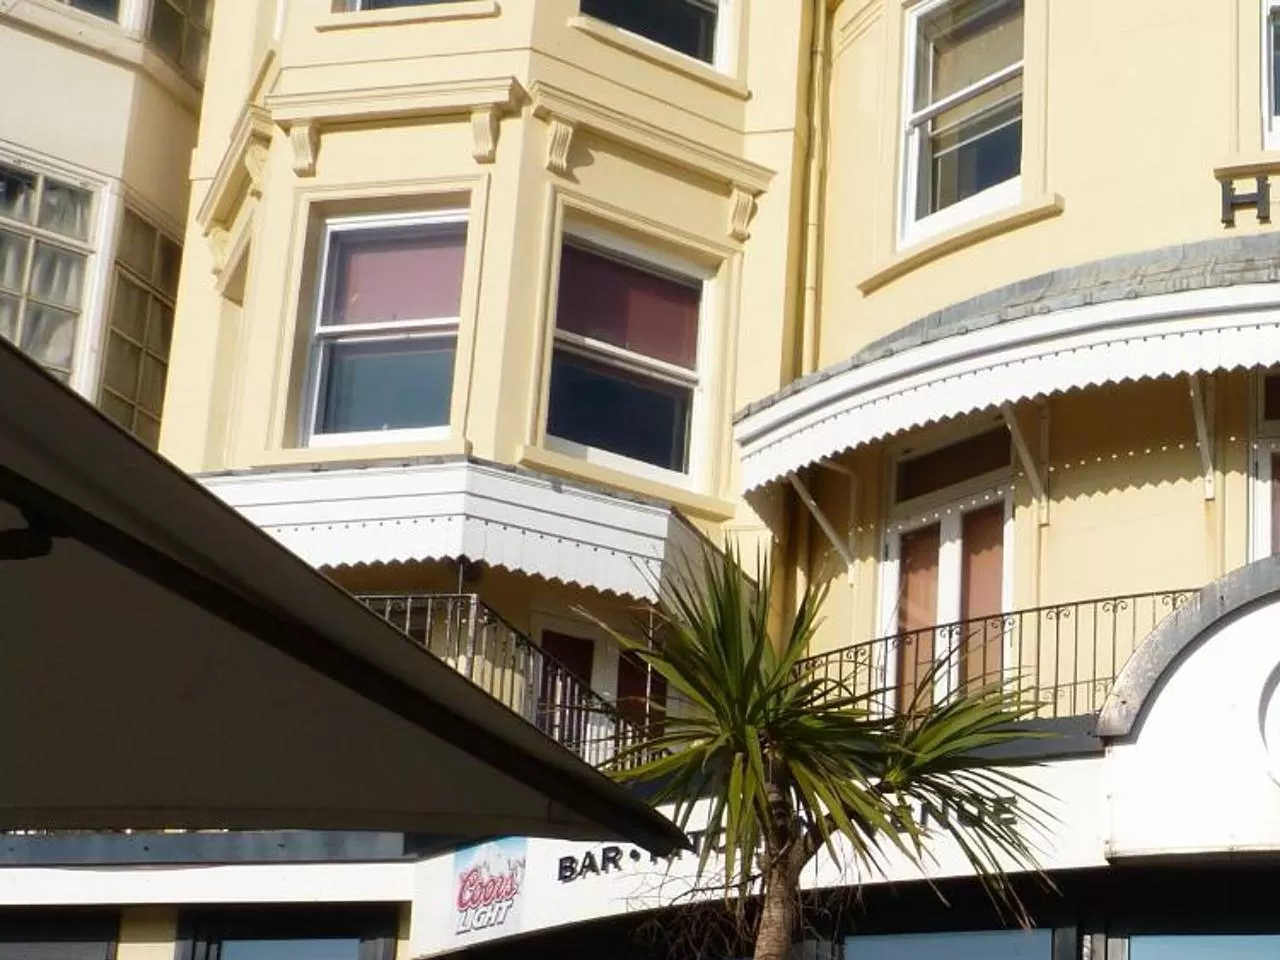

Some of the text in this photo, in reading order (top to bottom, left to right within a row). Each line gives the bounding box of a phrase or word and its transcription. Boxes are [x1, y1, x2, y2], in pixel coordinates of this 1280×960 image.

[558, 846, 622, 883] BAR
[457, 867, 519, 911] Coors
[455, 899, 513, 935] LIGHT
